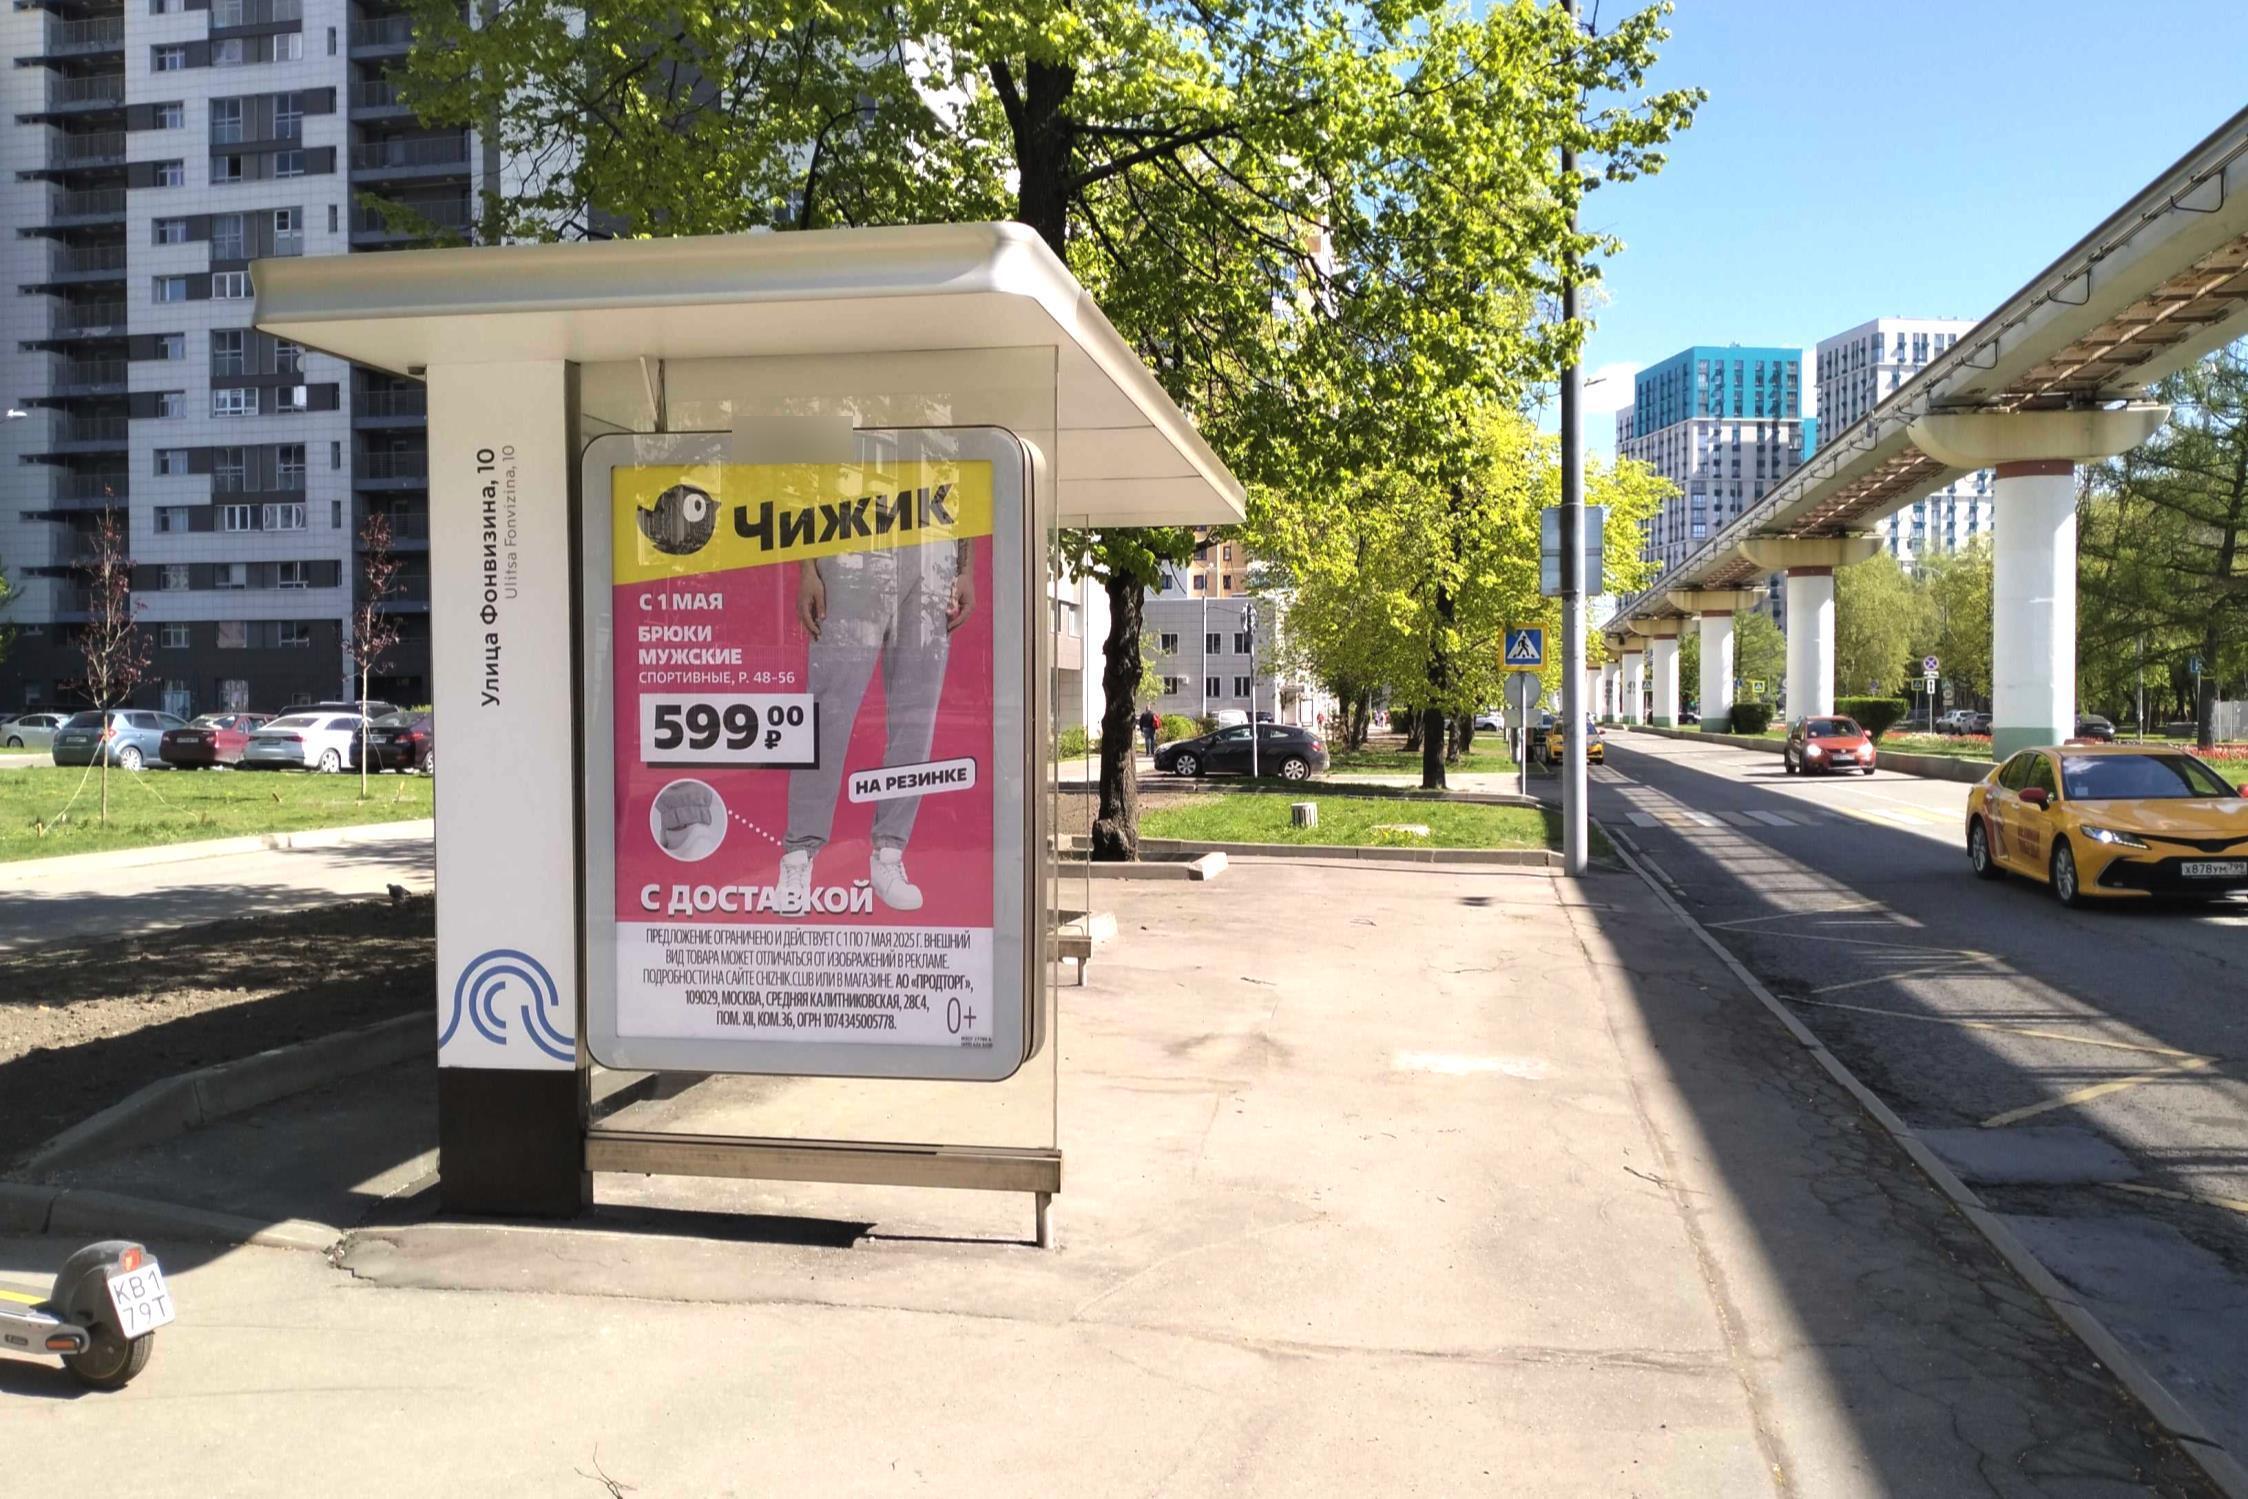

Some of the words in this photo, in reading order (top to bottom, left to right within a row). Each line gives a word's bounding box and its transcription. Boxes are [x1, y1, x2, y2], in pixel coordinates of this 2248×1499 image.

[477, 448, 495, 473] 10
[502, 445, 515, 462] 10
[503, 465, 517, 547] Fonvizina,
[480, 479, 499, 625] Фонвизина,
[503, 551, 517, 599] Ulitsa
[639, 593, 653, 611] С
[656, 593, 667, 610] 1
[672, 593, 723, 611] МАЯ
[638, 625, 712, 643] БРЮКИ
[638, 648, 742, 666] МУЖСКИЕ
[481, 633, 501, 707] Улица
[638, 671, 736, 688] СПОРТИВНЫЕ,
[738, 671, 750, 684] Р.
[753, 671, 796, 685] 48-56
[653, 704, 760, 750] 599
[767, 705, 804, 727] 00
[855, 779, 883, 795] НА
[886, 768, 968, 791] РЕЗИНКЕ
[640, 884, 661, 911] С
[668, 880, 874, 916] ДОСТАВКОЙ
[646, 928, 713, 946] ПРЕДЛОЖЕНИЕ
[713, 929, 774, 945] ОГРАНИЧЕНО
[774, 930, 782, 945] И
[783, 927, 834, 948] ДЕЙСТВУЕТ
[836, 931, 841, 947] С
[844, 932, 848, 947] 1
[850, 932, 863, 947] ПО
[864, 932, 870, 947] 7
[871, 932, 892, 947] МАЯ
[893, 932, 915, 948] 2025
[915, 933, 923, 948] Г.
[924, 930, 971, 949] ВНЕШНИЙ
[666, 949, 684, 967] ВИД
[686, 950, 720, 965] ТОВАРА
[720, 951, 754, 966] МОЖЕТ
[756, 951, 813, 966] ОТЛИЧАТЬСЯ
[814, 951, 826, 967] ОТ
[827, 949, 896, 968] ИЗОБРАЖЕНИЙ
[897, 953, 904, 968] В
[905, 953, 950, 969] РЕКЛАМЕ.
[643, 968, 710, 986] ПОДРОБНОСТИ
[711, 970, 725, 984] НА
[726, 967, 755, 985] САЙТЕ
[756, 971, 814, 986] CHIZHIK.CLUB
[815, 972, 836, 987] ИЛИ
[837, 973, 843, 987] В
[844, 973, 894, 988] МАГАЗИНЕ.
[895, 974, 909, 988] АО
[911, 974, 974, 993] «ПРОДТОРГ»,
[685, 990, 720, 1008] 109029,
[721, 990, 764, 1008] МОСКВА,
[766, 991, 809, 1009] СРЕДНЯЯ
[810, 992, 902, 1012] КАЛИТНИКОВСКАЯ,
[717, 1010, 741, 1026] ПОМ.
[797, 1013, 822, 1028] ОГРН
[823, 1013, 897, 1030] 1074345005778.
[947, 997, 977, 1034] 0+
